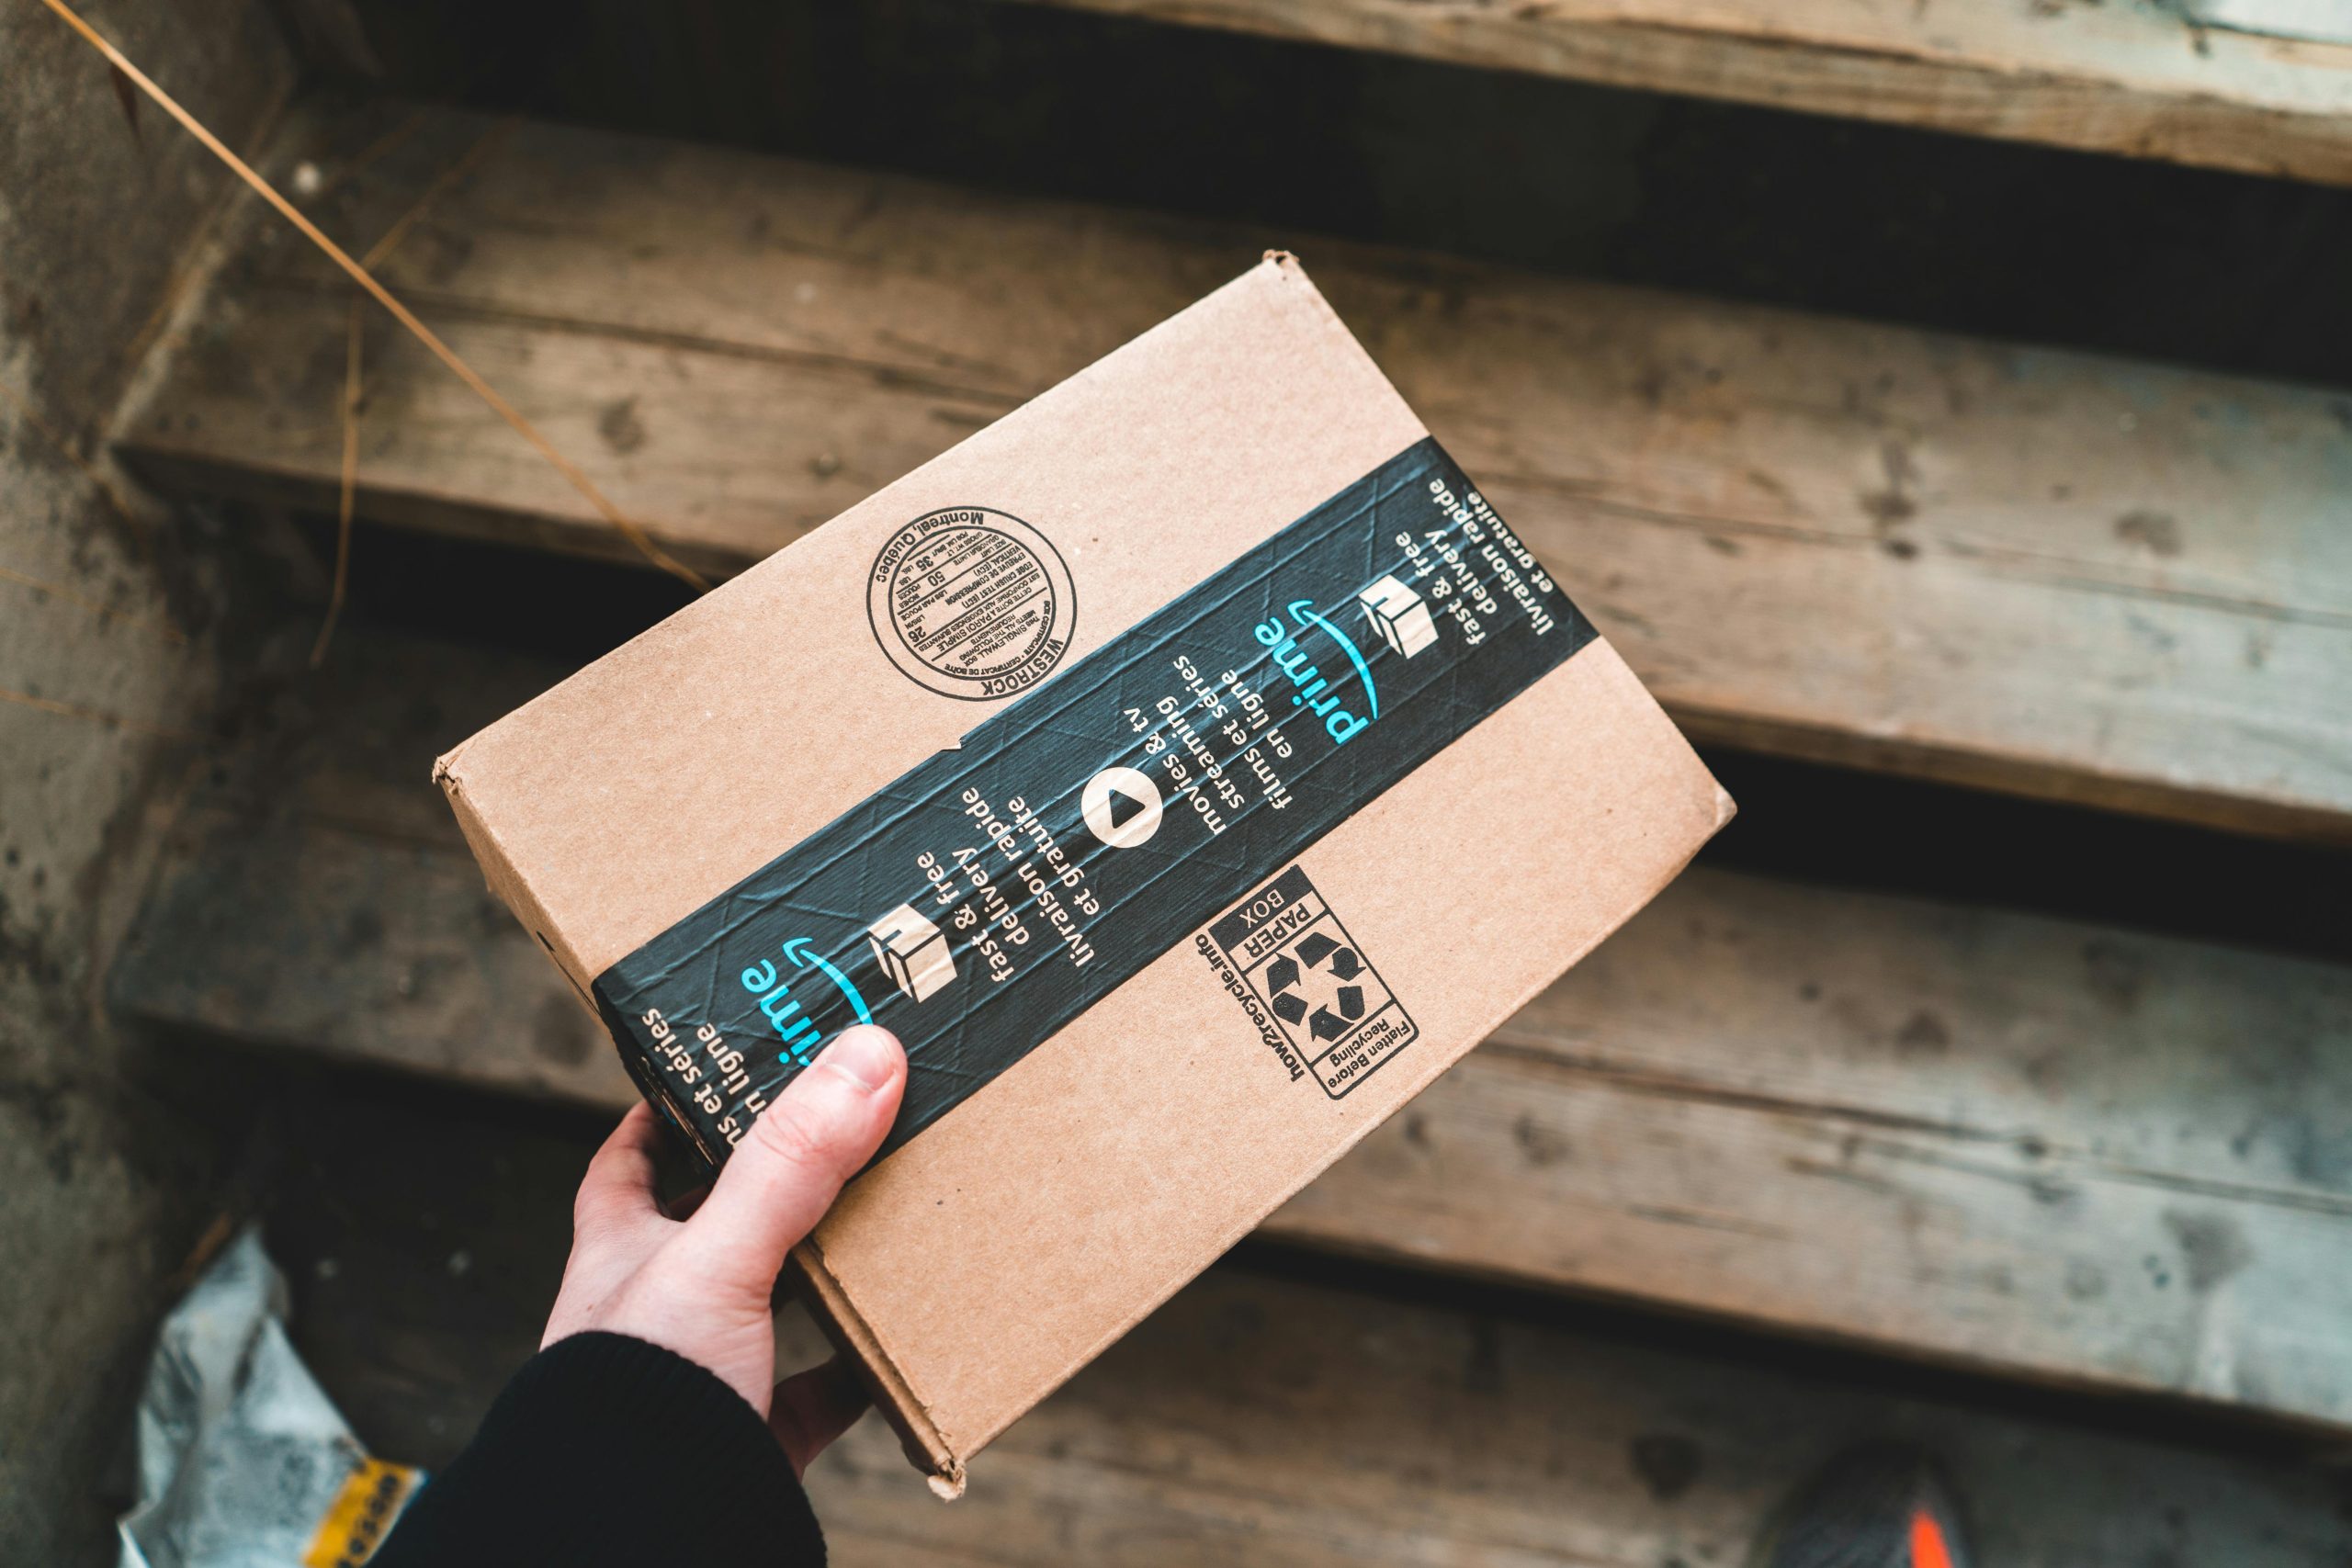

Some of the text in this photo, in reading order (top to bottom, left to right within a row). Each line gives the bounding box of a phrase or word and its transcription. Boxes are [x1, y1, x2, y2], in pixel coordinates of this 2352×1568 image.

[875, 533, 916, 583] Québec
[915, 555, 934, 572] 35
[1430, 479, 1554, 635] livraison rapide
[1468, 493, 1553, 592] et gratuite
[898, 583, 922, 601] POUCES
[899, 592, 921, 609] INCHES
[900, 545, 1021, 622] VERTICAL (ECV) LBS PAR POUCE
[927, 570, 945, 587] 50
[944, 574, 990, 606] COMPRESSION
[988, 569, 1000, 579] DE
[1012, 586, 1032, 602] CETTE
[1396, 532, 1486, 645] fast & free
[1425, 530, 1497, 614] delivery
[908, 561, 1034, 643] EDGE CRUSH TEST (ECT) 26
[918, 572, 1040, 652] EST CONFORME AUX EXIGENCES SUIVANTES
[966, 613, 992, 633] PAROI
[970, 614, 1016, 646] REQUIREMENTS
[936, 628, 967, 652] SIMPLE
[958, 609, 1036, 661] MEETS ALL THE FOLLOWING
[963, 655, 978, 668] BOX
[977, 624, 1027, 659] SINGLEWALL
[1023, 615, 1050, 656] CERTIFICATE
[968, 668, 979, 676] DE
[980, 638, 1064, 696] WESTROCK
[981, 656, 1022, 675] CERTIFICAT
[1254, 617, 1369, 744] prime
[1173, 656, 1293, 809] films et séries
[1221, 670, 1292, 758] en ligne
[1124, 708, 1227, 835] movies & tv
[1156, 696, 1245, 808] streaming
[962, 787, 1094, 967] livraison rapide
[1008, 796, 1100, 915] et gratuite
[917, 852, 1014, 982] fast & free
[952, 848, 1029, 944] delivery
[1239, 889, 1284, 929] BOX
[1243, 903, 1311, 958] PAPER
[1195, 934, 1305, 1082] how2recycle.info
[642, 1009, 721, 1113] et séries
[697, 1023, 750, 1094] ligne
[1328, 1021, 1410, 1088] Flatten Before
[1329, 1019, 1390, 1067] Recycling
